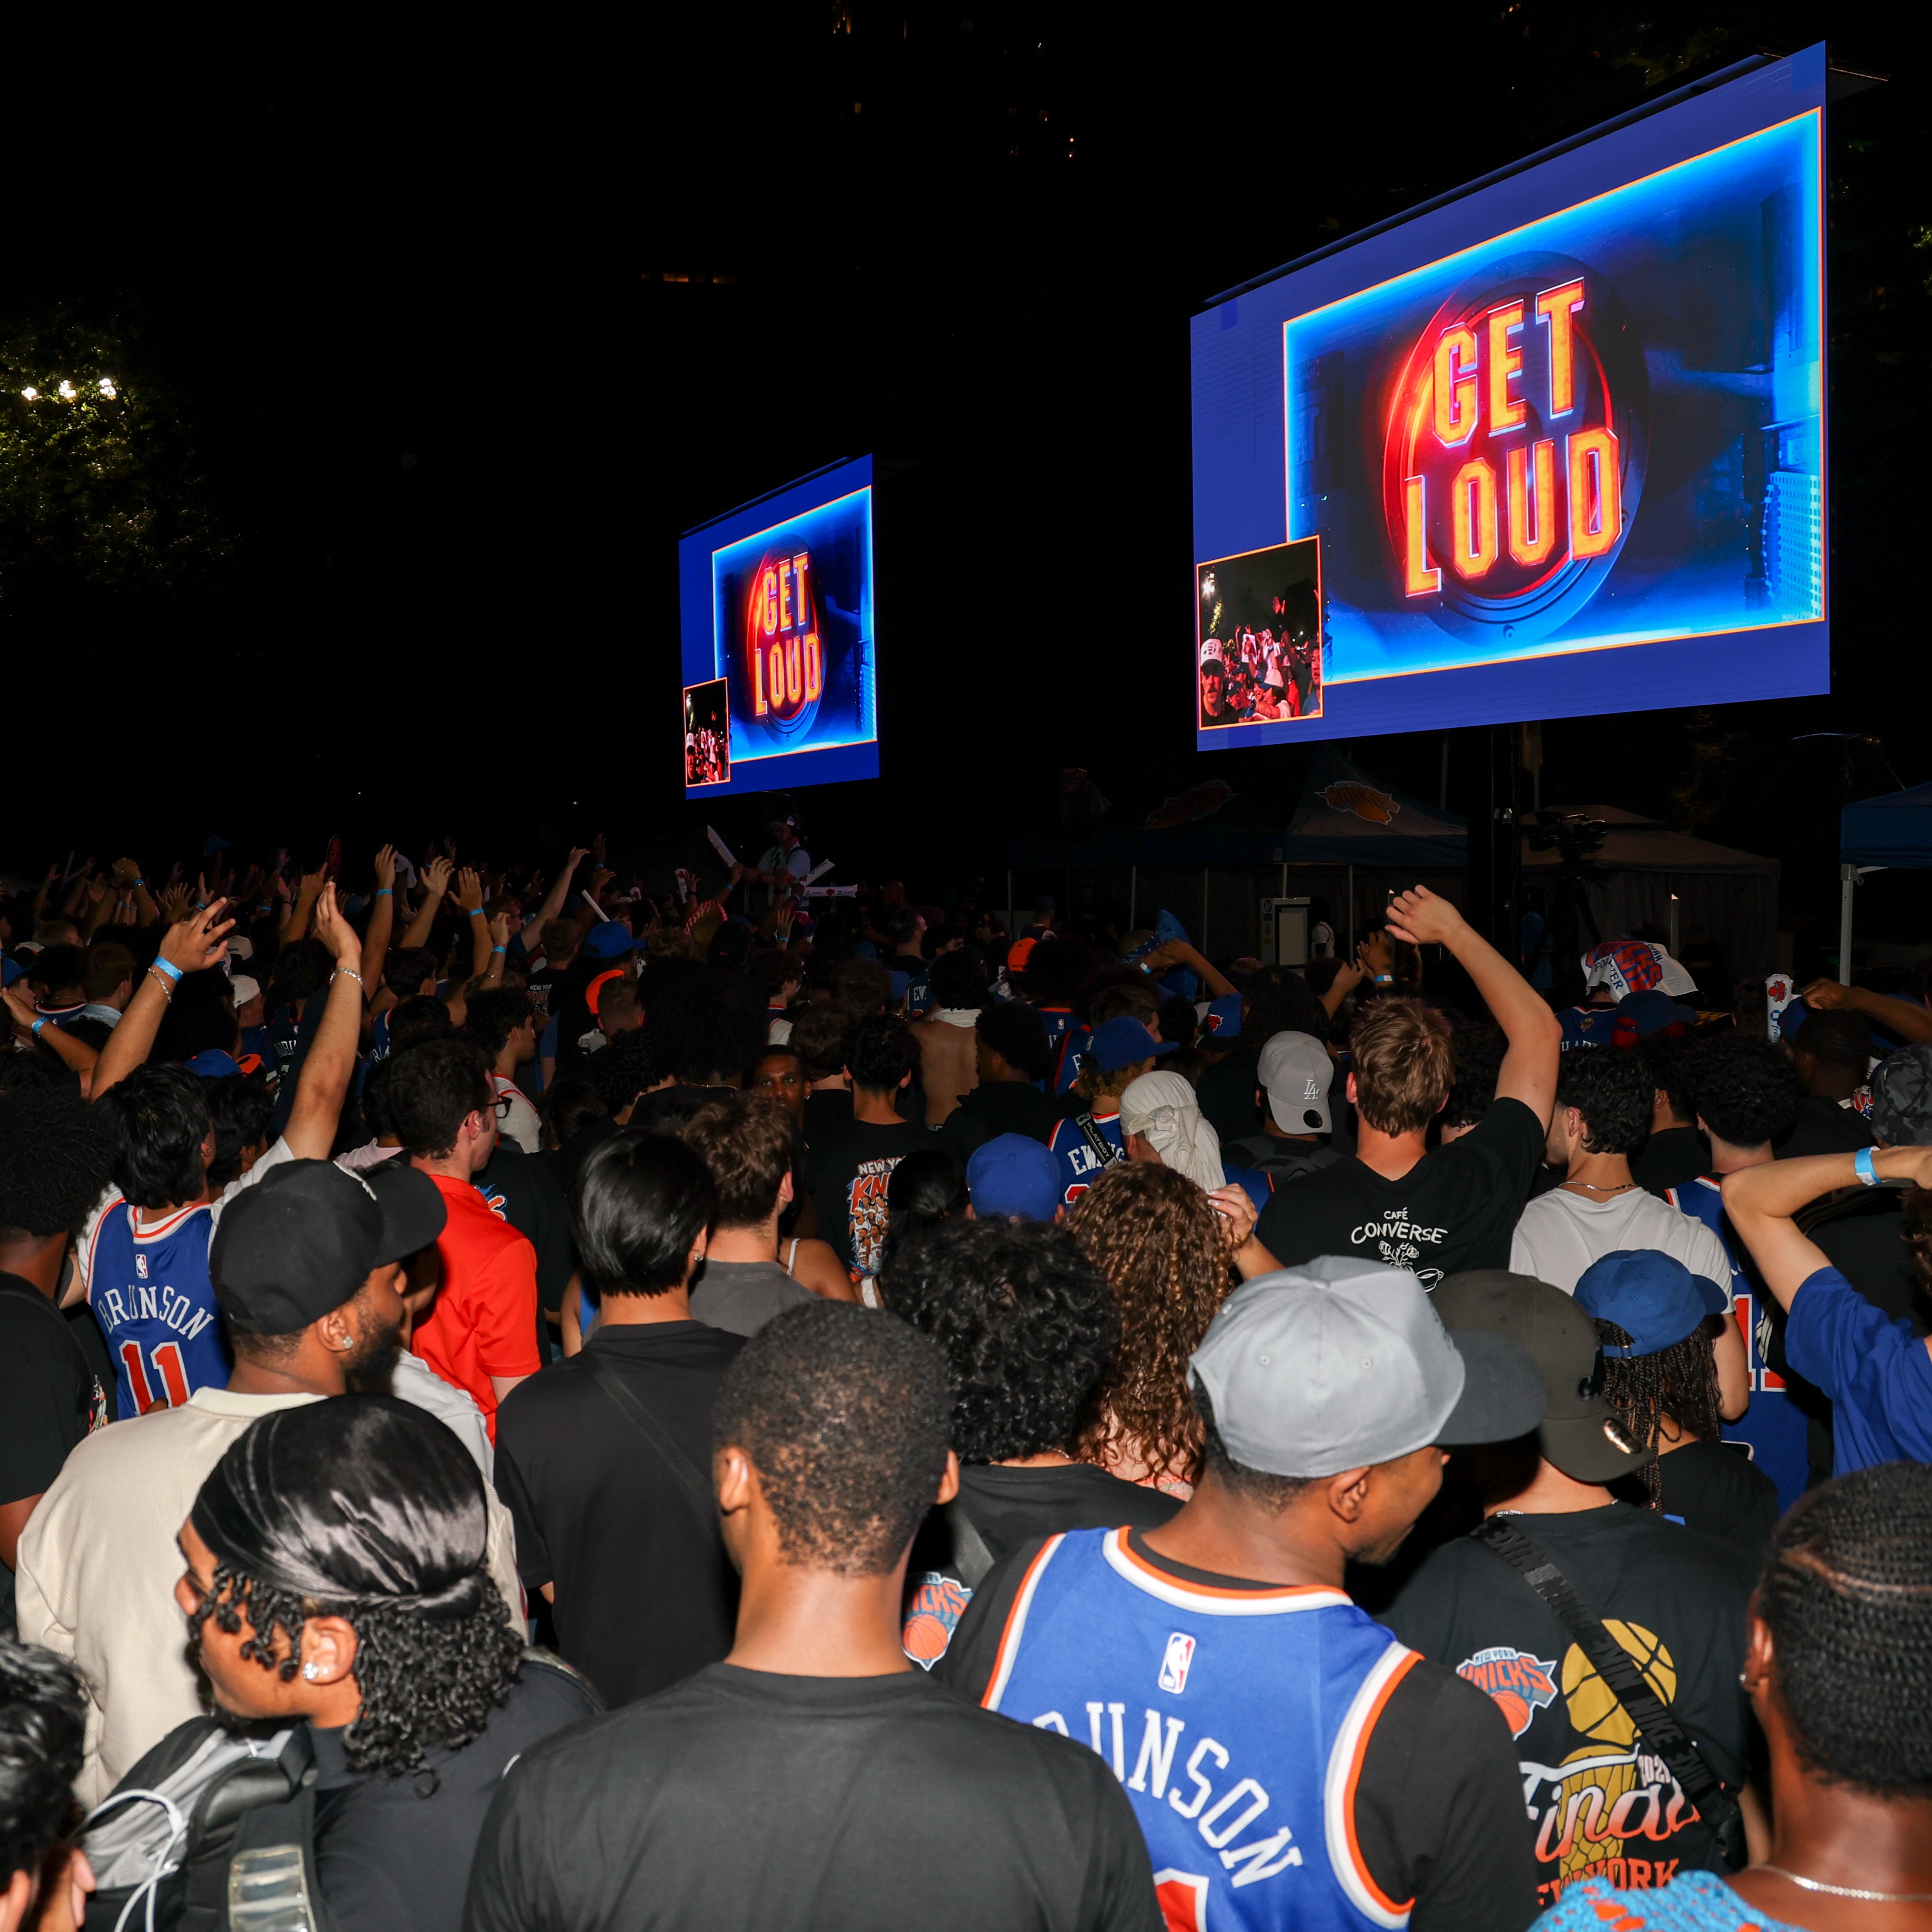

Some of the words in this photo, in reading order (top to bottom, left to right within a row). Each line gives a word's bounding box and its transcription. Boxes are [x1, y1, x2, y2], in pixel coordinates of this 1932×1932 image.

[1432, 277, 1584, 447] GET
[1405, 427, 1621, 597] LOUD
[762, 551, 809, 635] GET
[754, 632, 822, 716] LOUD
[1304, 1079, 1320, 1100] LA
[859, 1160, 885, 1174] NEW
[1086, 1122, 1110, 1157] PLAYBOY
[1351, 1221, 1448, 1244] CONVERSE
[1384, 1207, 1408, 1220] CAFÉ
[98, 1284, 215, 1341] BRUNSON
[119, 1339, 191, 1417] 11
[1476, 1653, 1492, 1664] NEW
[1624, 1694, 1687, 1748] NIKE
[1032, 1701, 1303, 1889] UNSON
